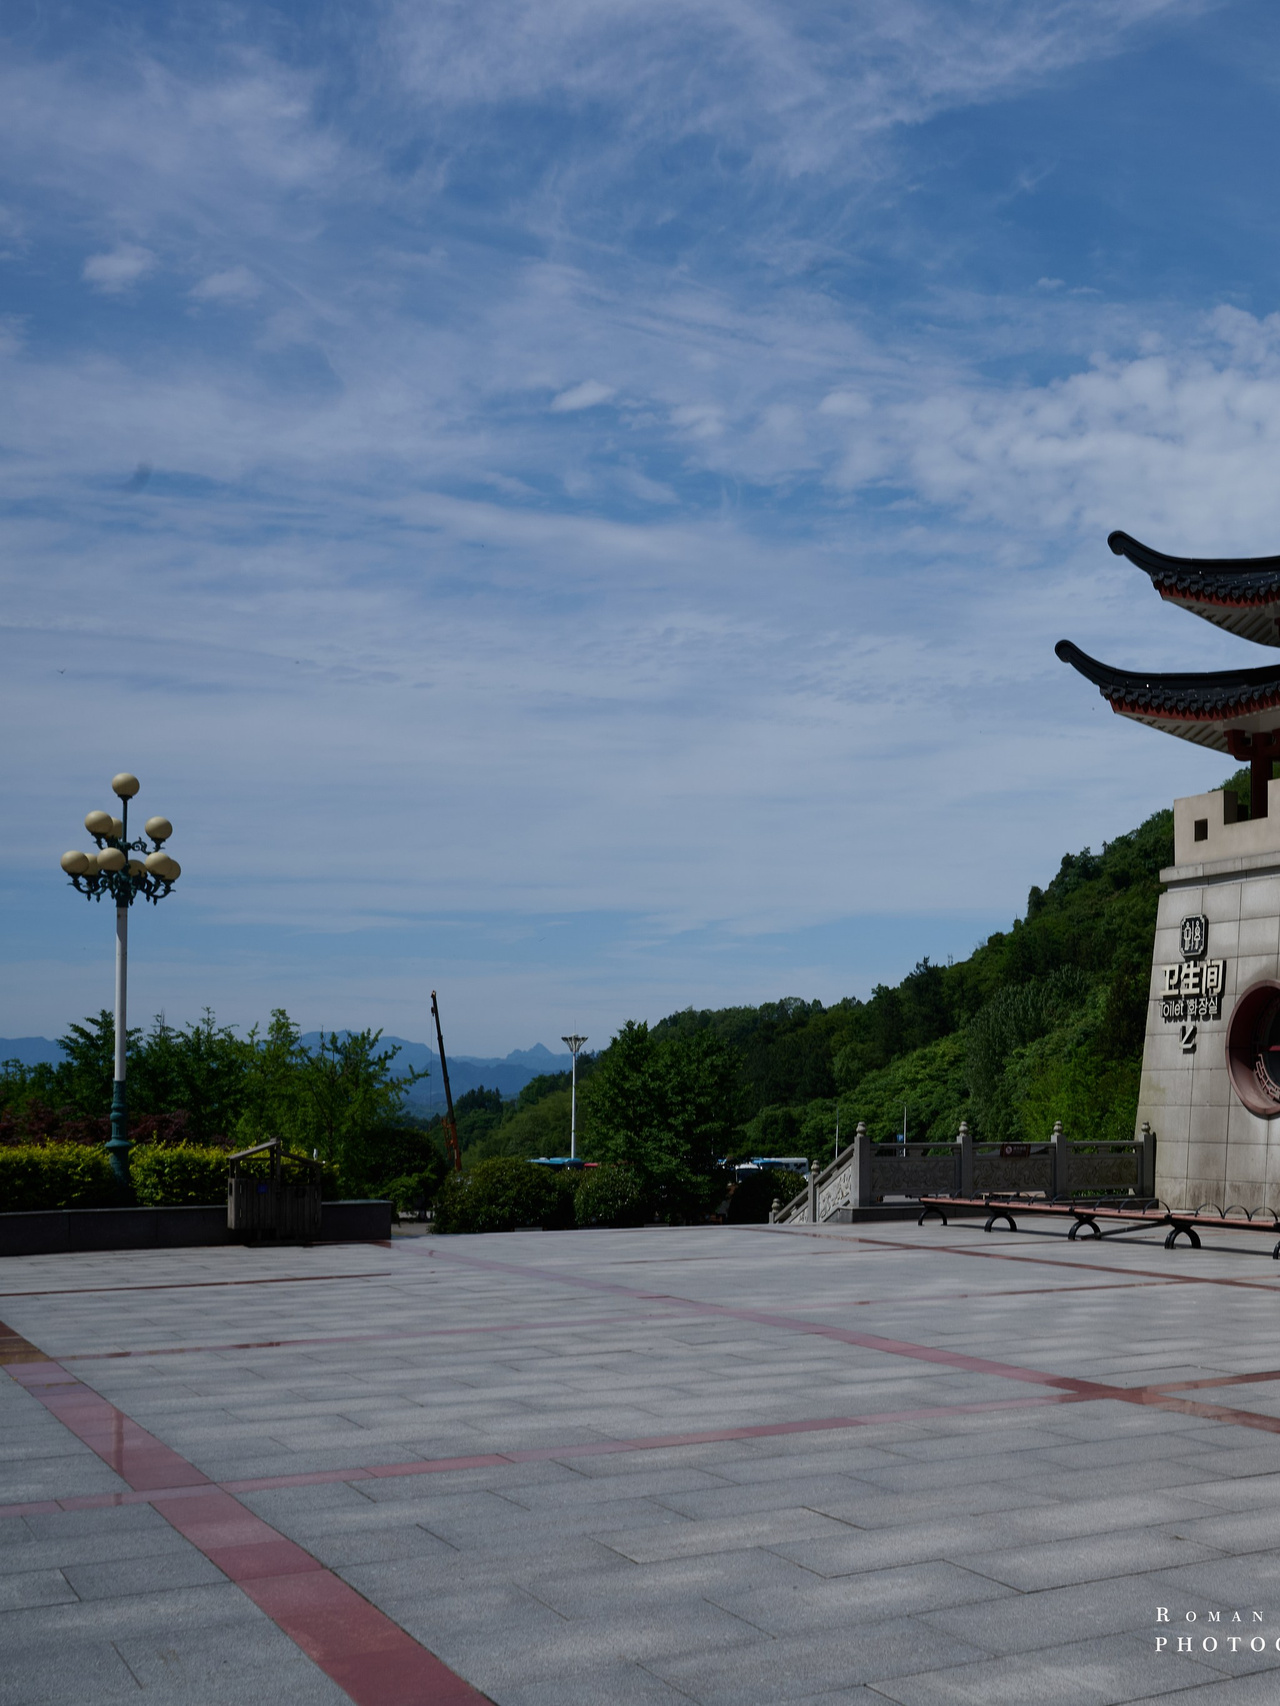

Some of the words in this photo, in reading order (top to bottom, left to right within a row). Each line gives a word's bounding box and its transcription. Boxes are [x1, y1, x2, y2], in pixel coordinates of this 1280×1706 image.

[1160, 959, 1223, 996] 卫生间
[1160, 1001, 1184, 1017] Toilet
[1188, 997, 1218, 1016] 화장실
